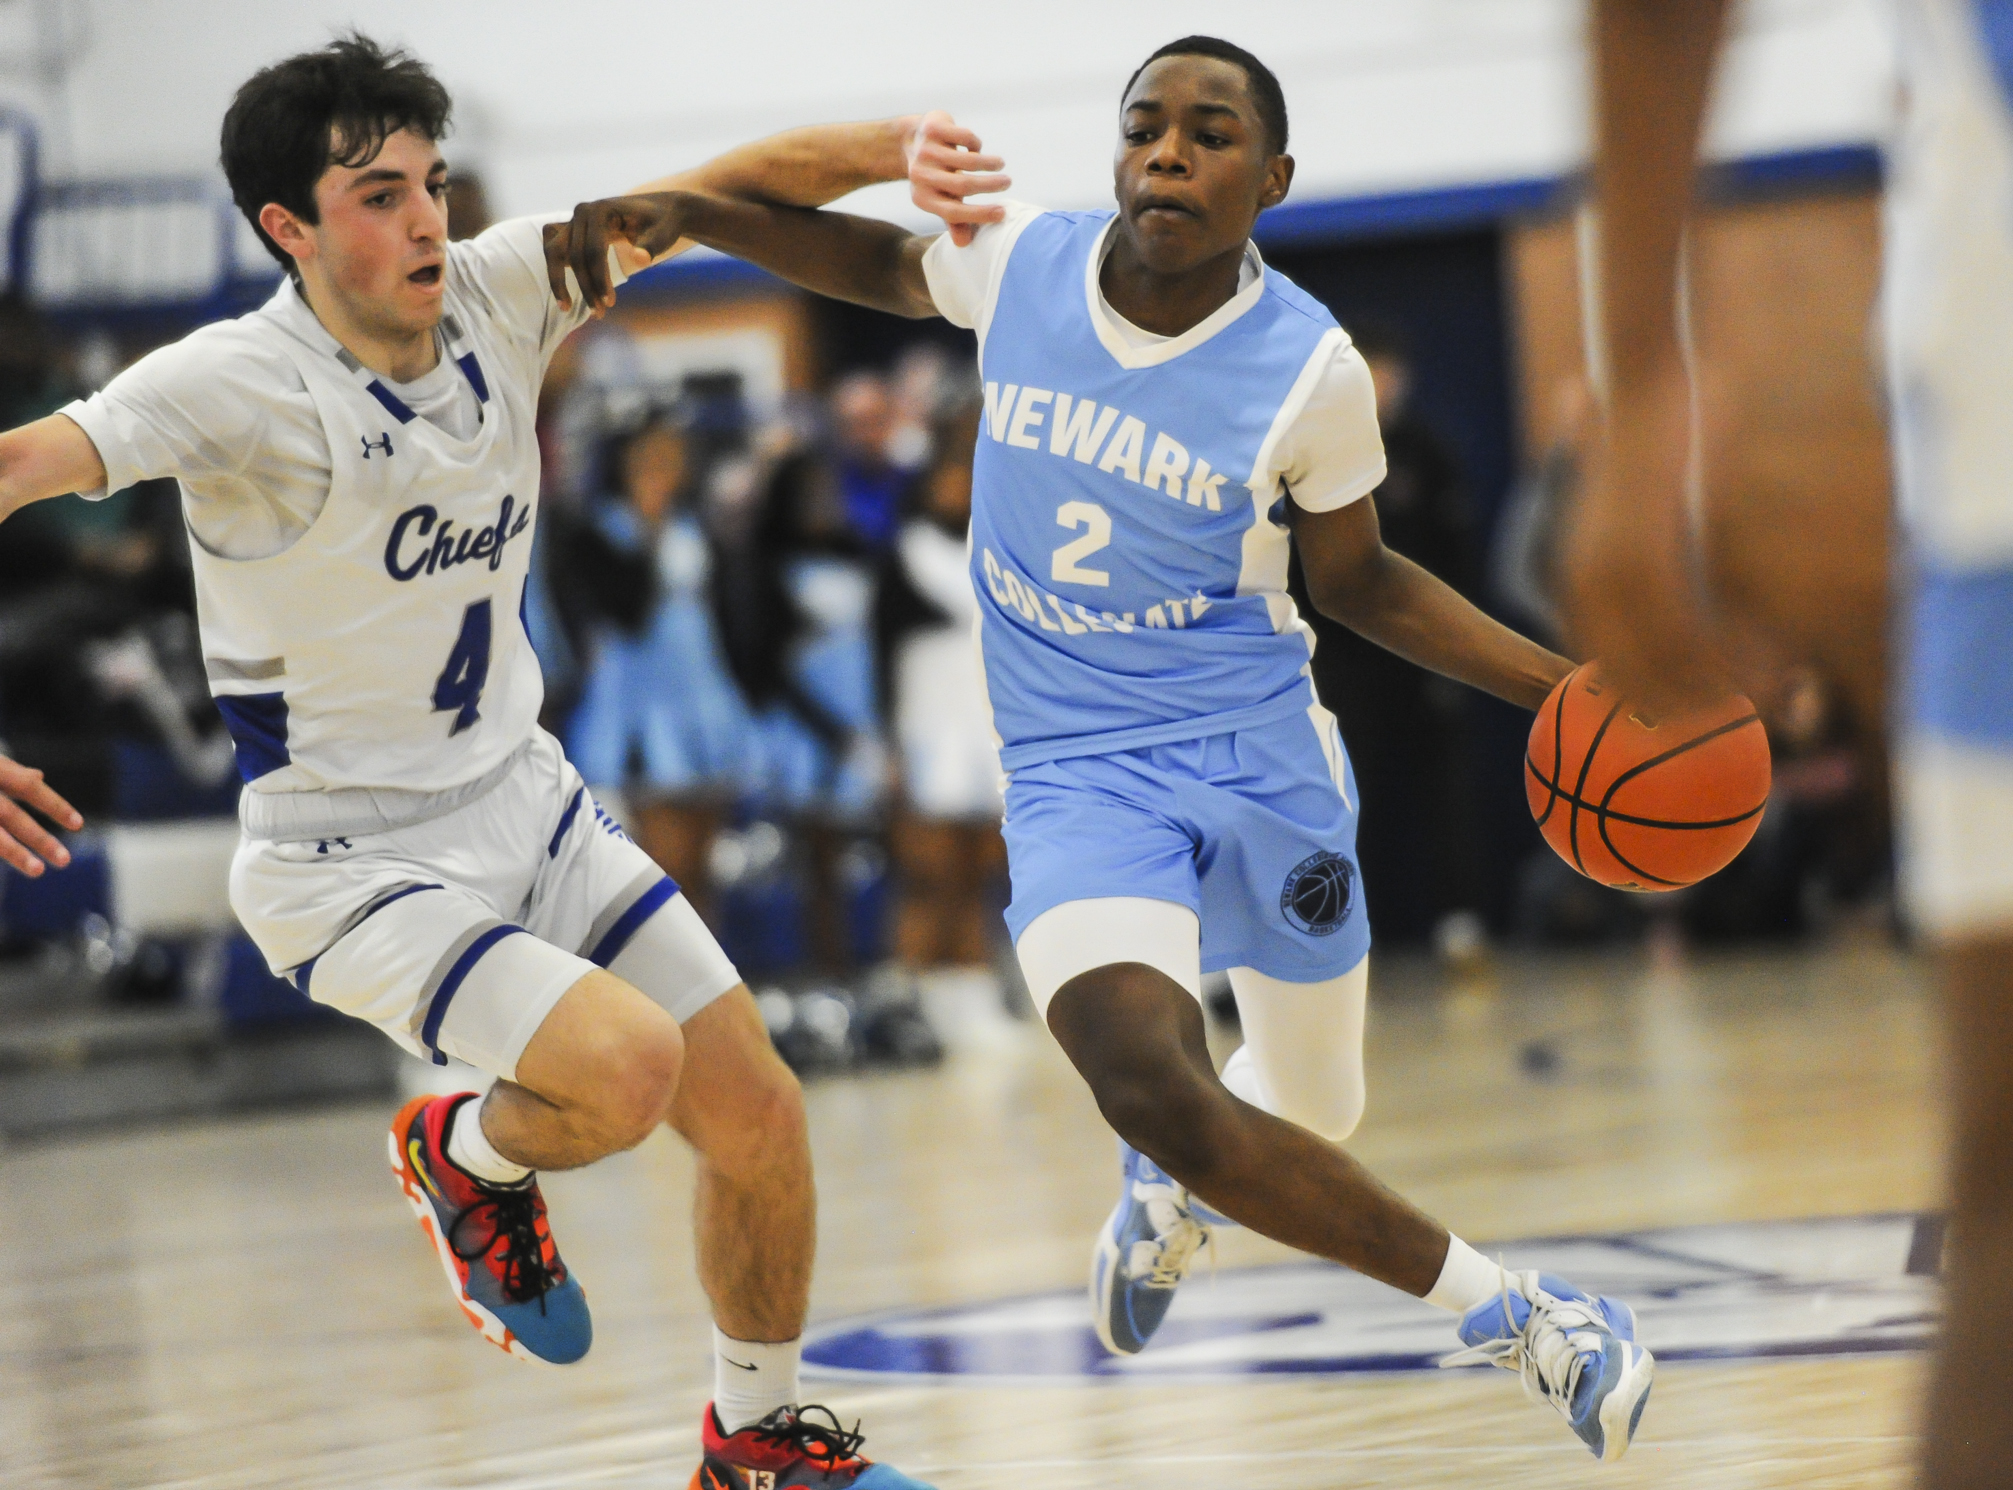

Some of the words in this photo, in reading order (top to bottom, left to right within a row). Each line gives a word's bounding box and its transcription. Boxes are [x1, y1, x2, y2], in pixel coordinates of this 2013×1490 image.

[985, 381, 1229, 512] NEWARK
[384, 494, 530, 582] Chiefs
[1052, 500, 1112, 588] 2
[430, 595, 492, 738] 4
